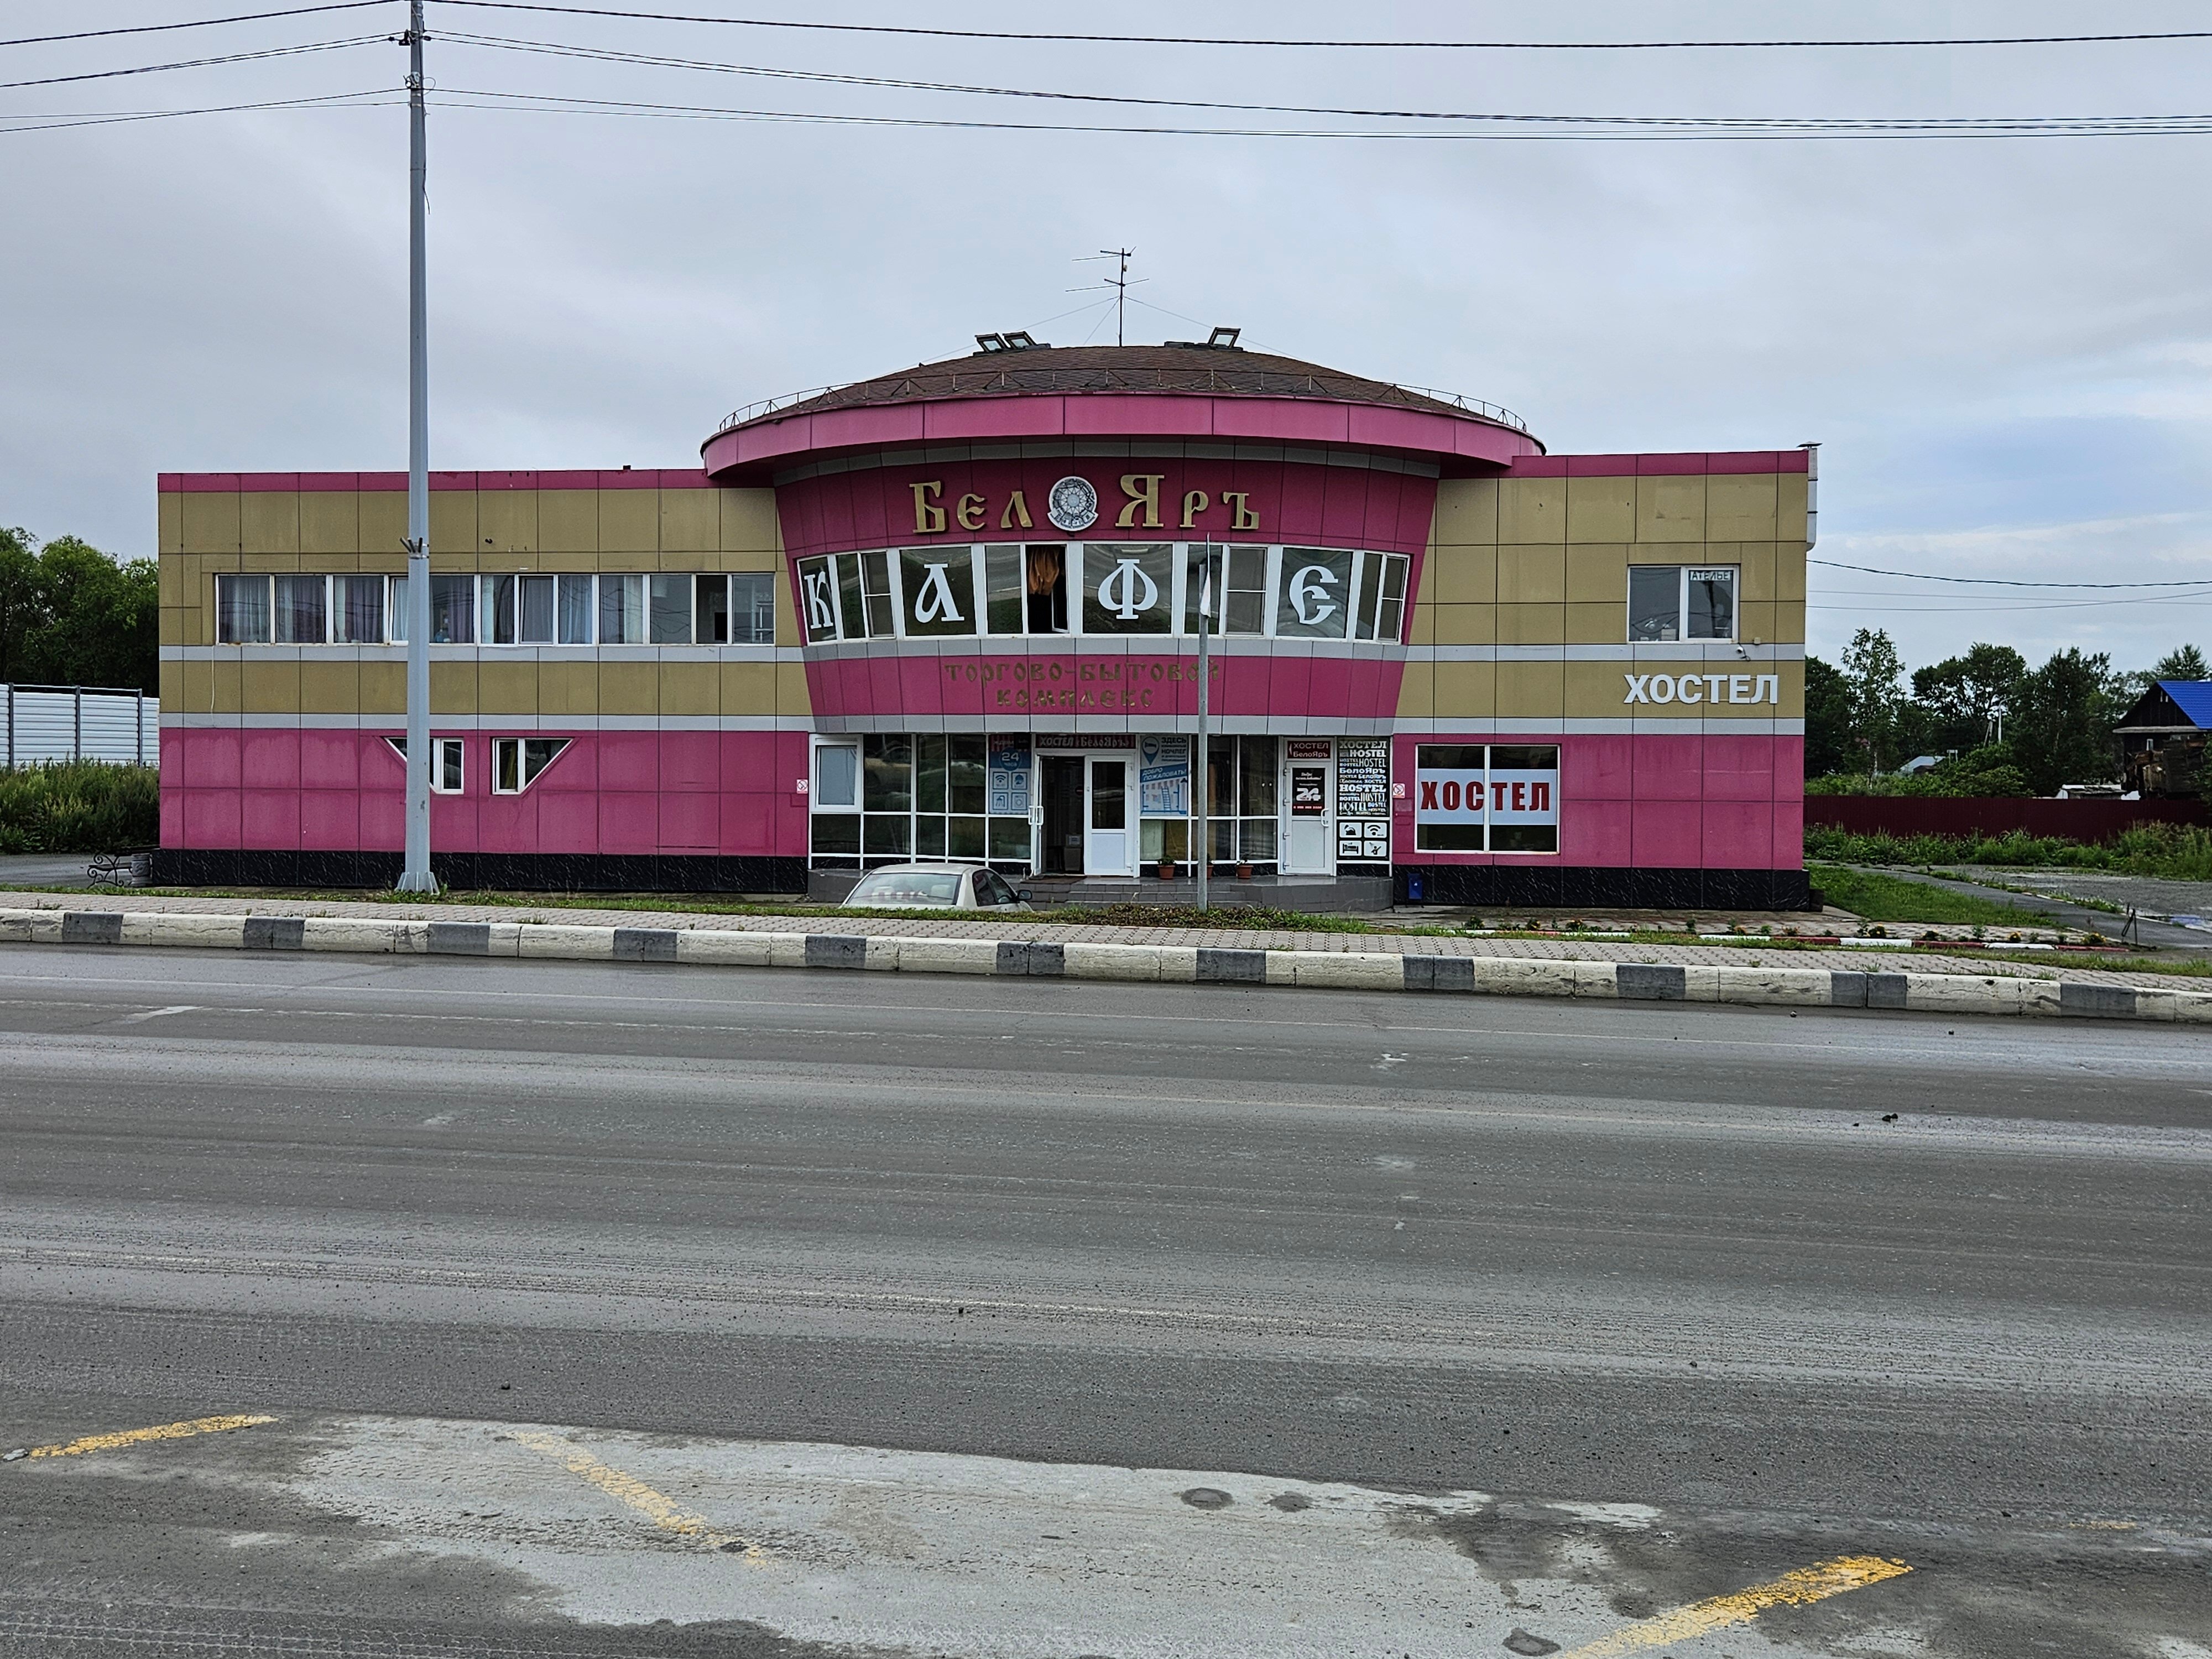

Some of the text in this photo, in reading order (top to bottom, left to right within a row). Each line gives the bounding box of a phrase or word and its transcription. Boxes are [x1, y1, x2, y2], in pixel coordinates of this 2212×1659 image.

[1623, 674, 1778, 705] ХОСТЕЛ
[1040, 737, 1074, 747] ХОСТЕЛ
[1001, 752, 1019, 761] 24
[1359, 758, 1386, 768] HOSTEL
[1339, 784, 1386, 792] HOSTEL
[1421, 780, 1550, 812] ХОСТЕЛ
